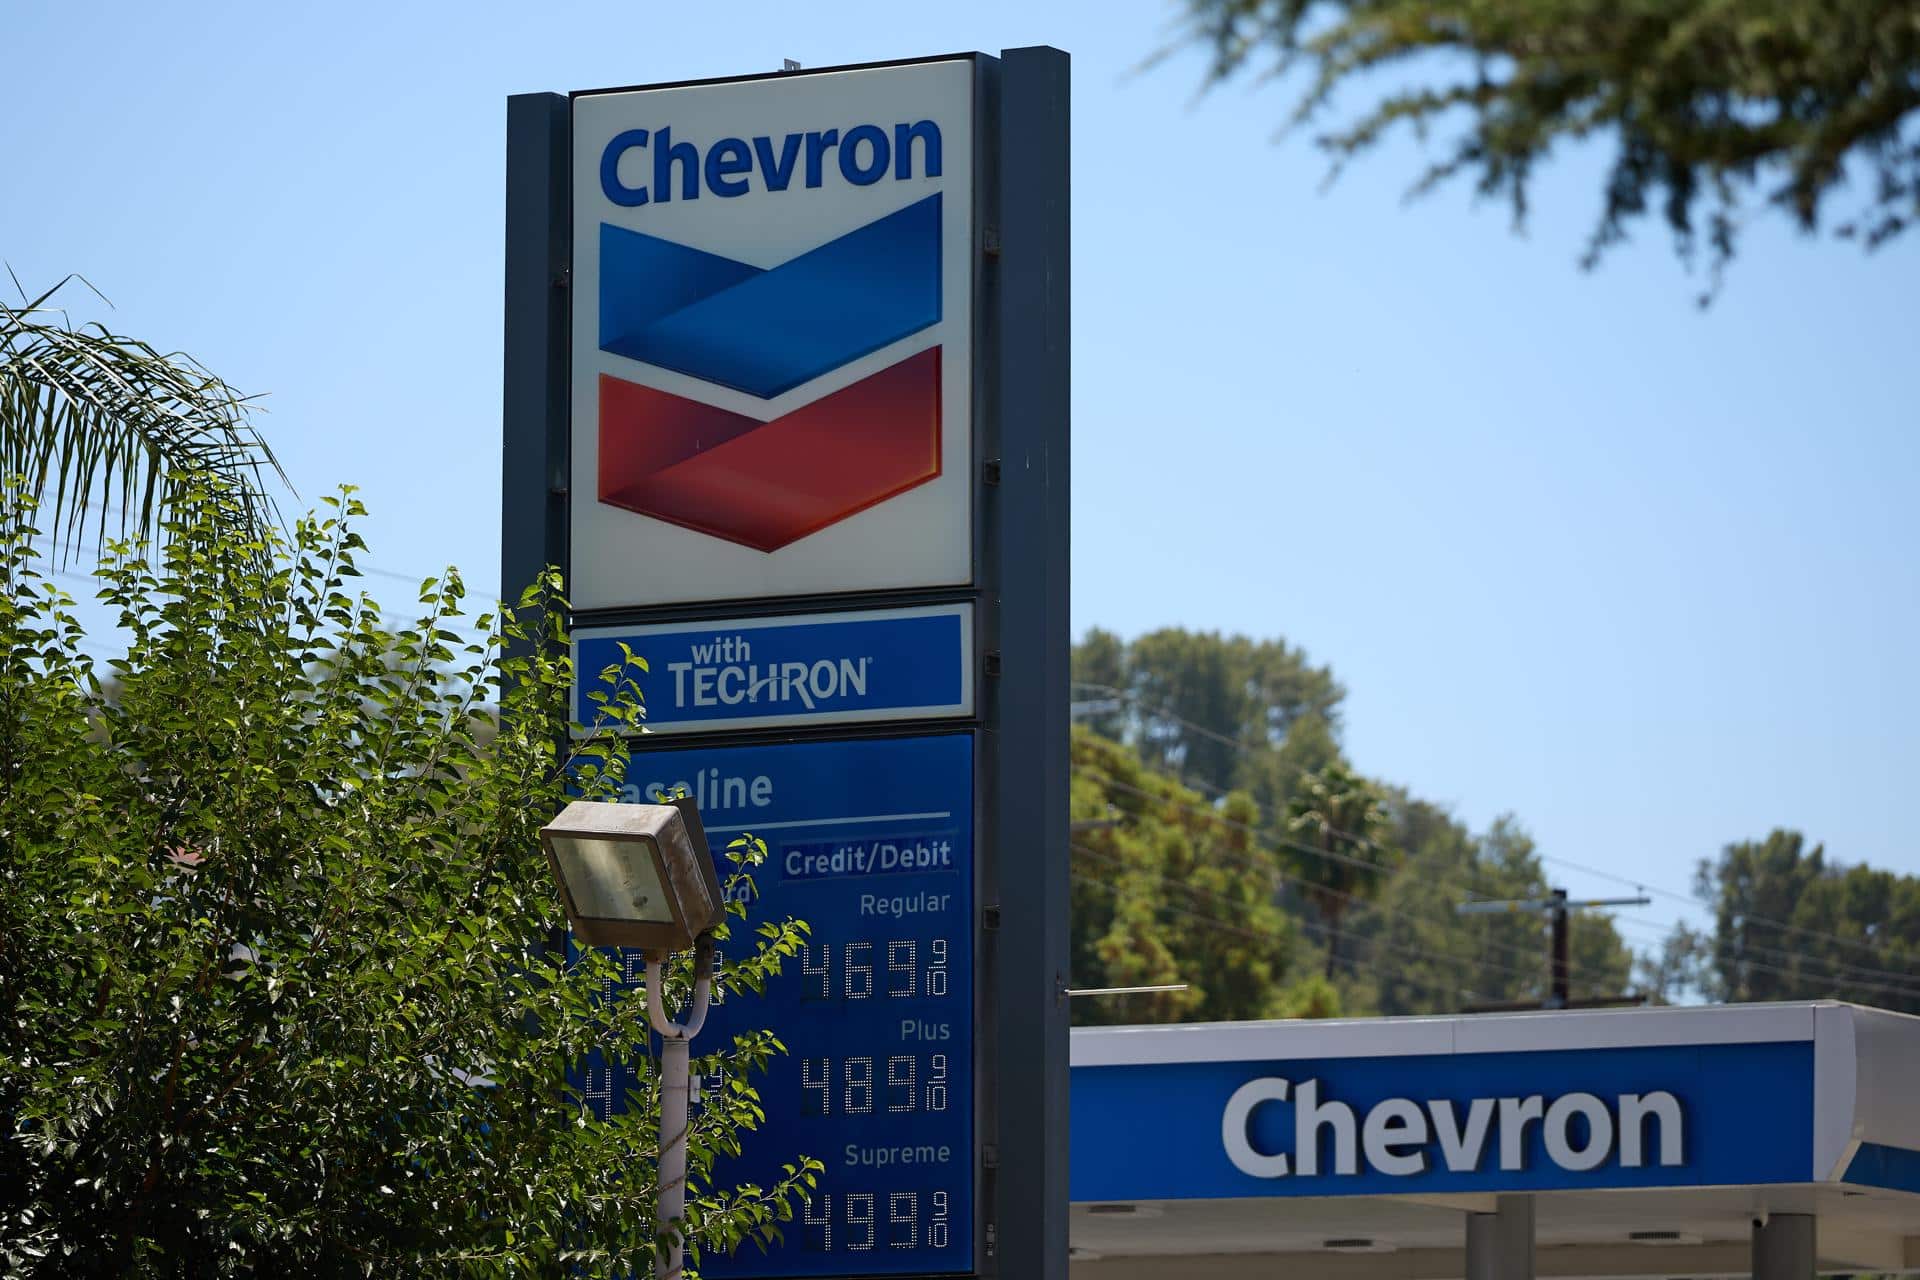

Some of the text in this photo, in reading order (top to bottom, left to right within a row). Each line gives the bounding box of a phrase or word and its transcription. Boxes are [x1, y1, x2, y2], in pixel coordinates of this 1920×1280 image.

[600, 120, 942, 207] Chevron
[691, 636, 750, 665] with
[785, 841, 951, 876] Credit/Debit
[860, 891, 950, 918] Regular
[803, 940, 916, 999] 469
[901, 1018, 950, 1041] Plus
[803, 1054, 916, 1115] 489
[1221, 1077, 1684, 1180] Chevron
[845, 1144, 951, 1169] Supreme
[804, 1191, 918, 1251] 499
